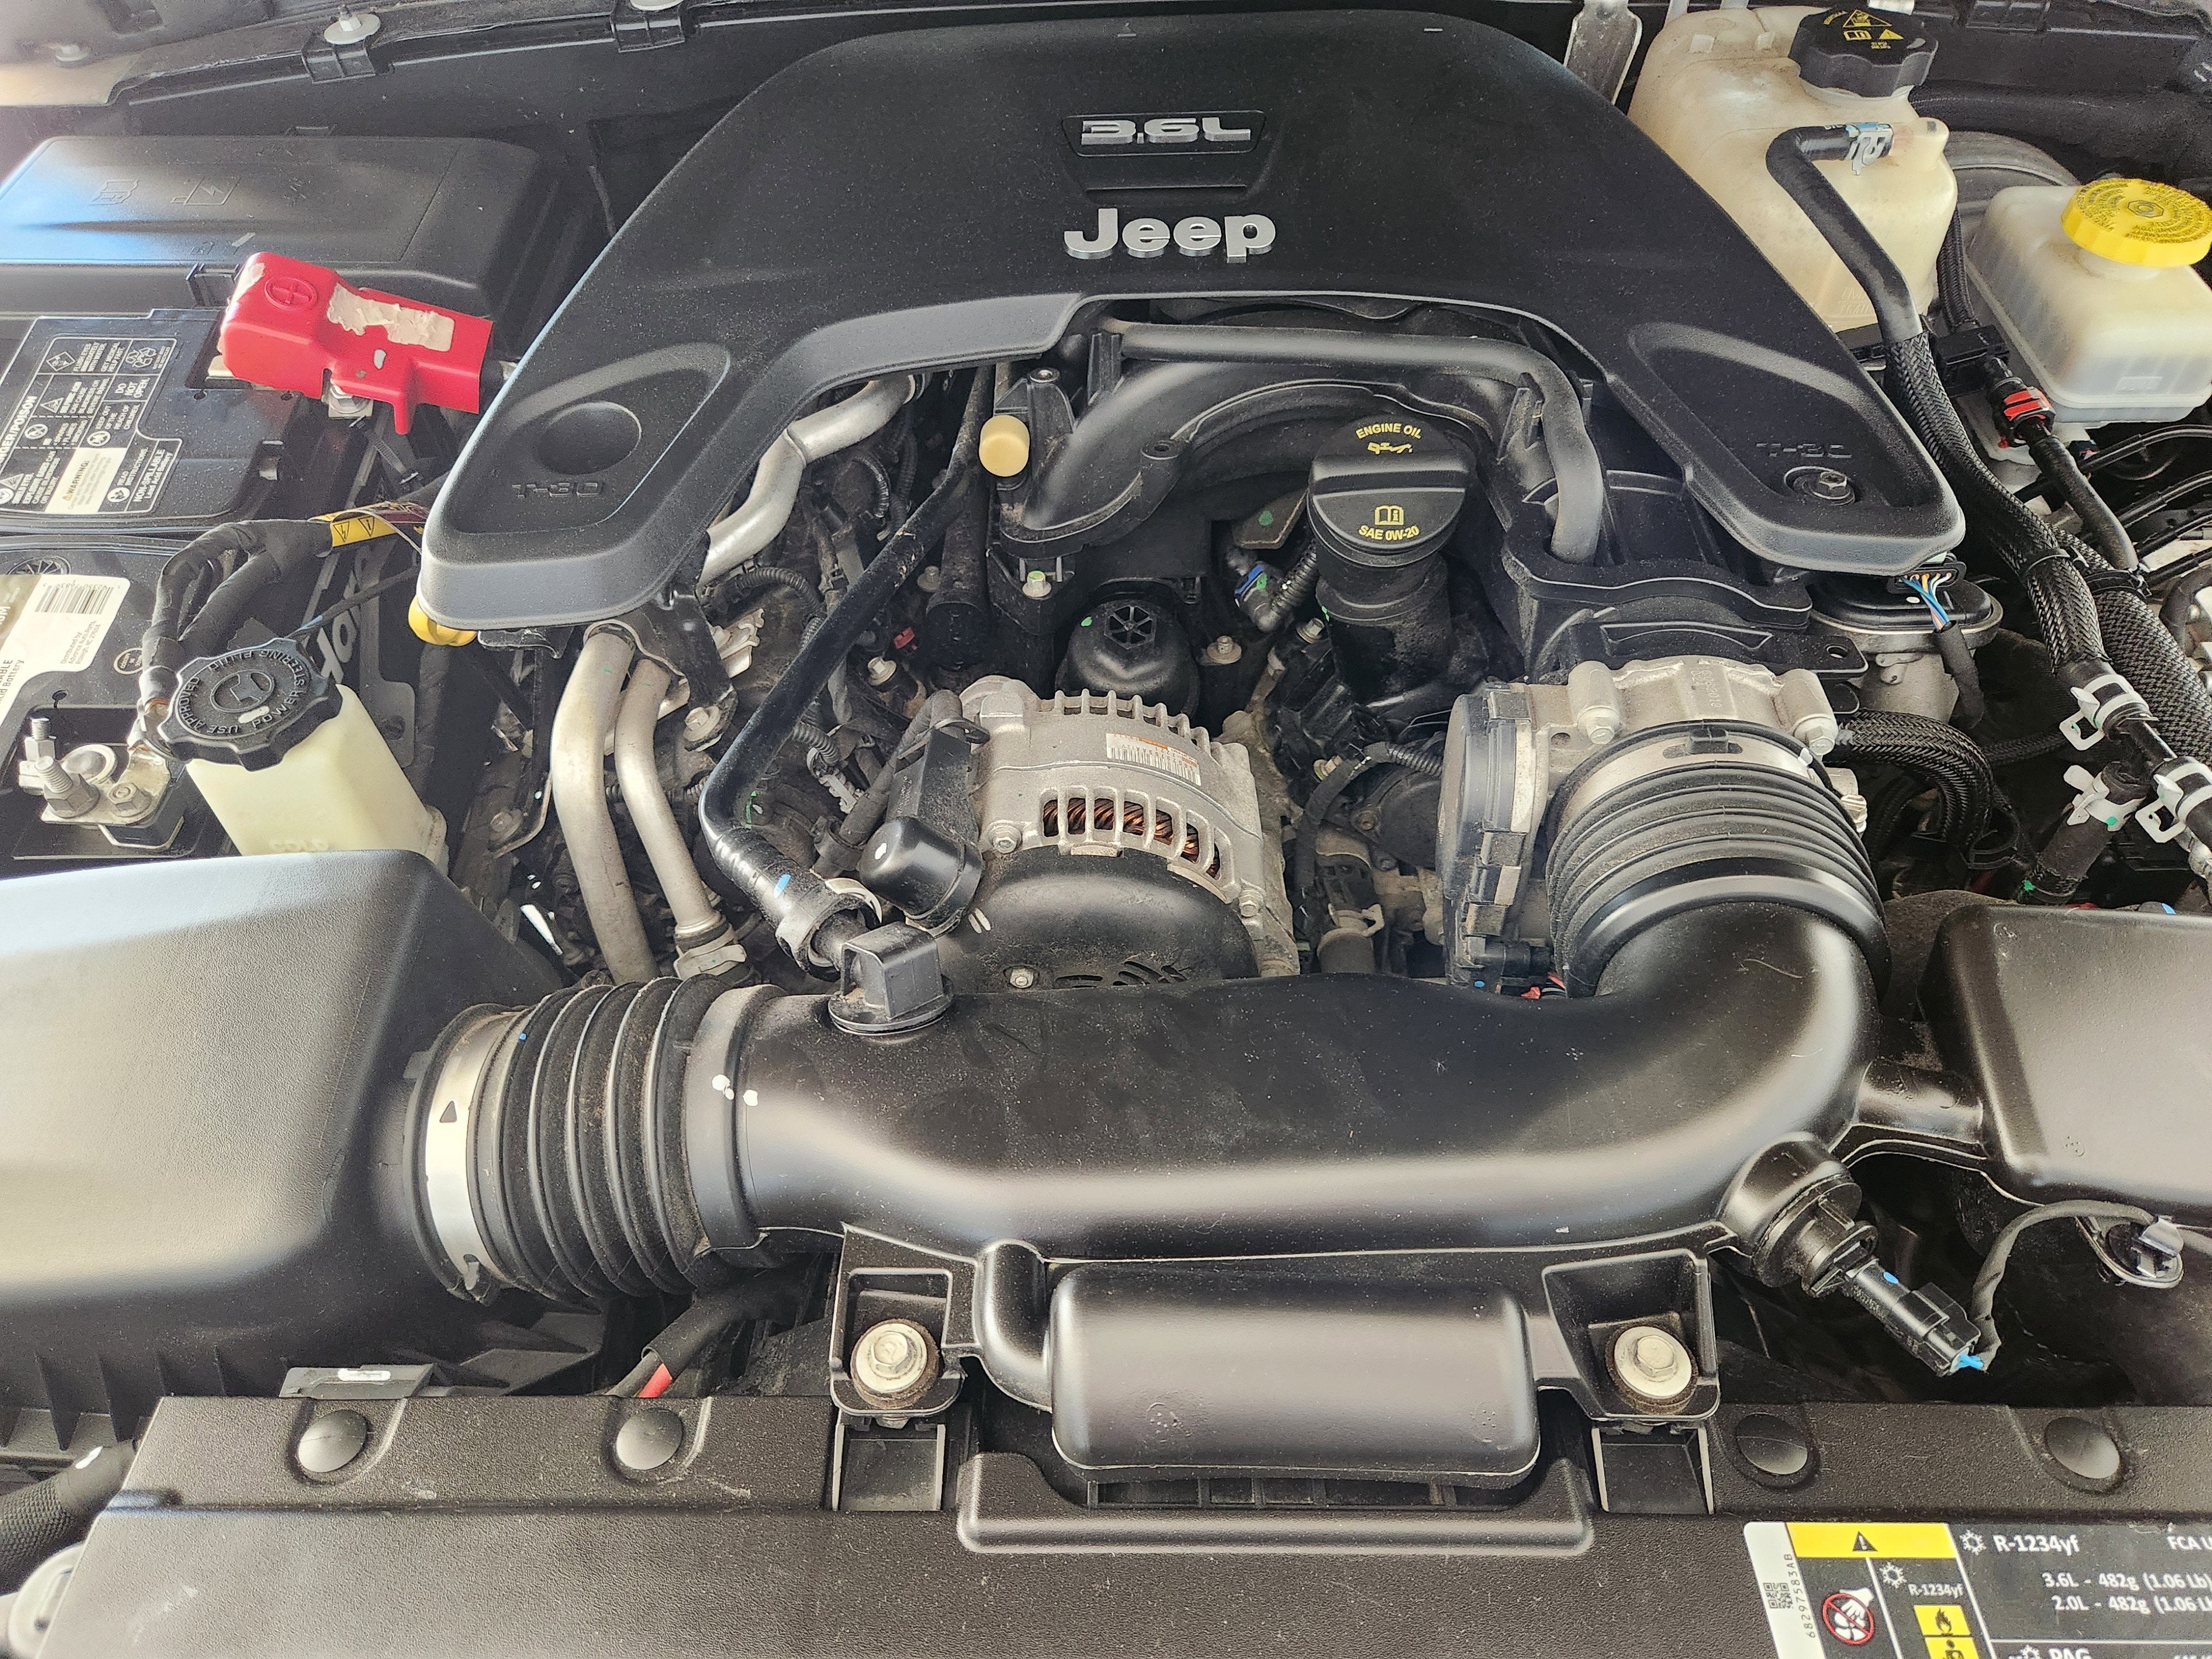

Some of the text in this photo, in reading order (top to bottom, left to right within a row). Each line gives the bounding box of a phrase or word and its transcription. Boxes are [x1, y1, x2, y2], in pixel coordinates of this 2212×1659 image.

[1081, 117, 1251, 145] 3.6L
[1063, 207, 1276, 264] Jeep
[115, 382, 128, 393] DO
[124, 381, 138, 395] NOT
[95, 405, 112, 429] KEEP OUT
[1355, 422, 1423, 439] ENGINE OIL
[66, 460, 90, 494] WARNING:
[118, 471, 129, 485] READ
[133, 448, 166, 502] NON-SPILLABLE
[144, 484, 156, 498] Lead
[151, 472, 163, 484] Acid
[1358, 524, 1420, 541] SAE 0W-20
[259, 649, 306, 687] STEERING
[179, 676, 239, 734] USE APPROVED
[252, 688, 302, 728] POWER
[1993, 1535, 2080, 1556] R-1234yf
[2167, 1535, 2200, 1550] FCA
[1907, 1583, 1967, 1599] R-1234yf
[2042, 1572, 2079, 1588] 3.6L
[2098, 1573, 2140, 1592] 482g
[2142, 1572, 2185, 1592] (1.06
[1784, 1553, 1816, 1639] 68297583AB
[2051, 1595, 2089, 1610] 2.0L
[2108, 1595, 2152, 1615] 482g
[2153, 1595, 2197, 1615] (1.06
